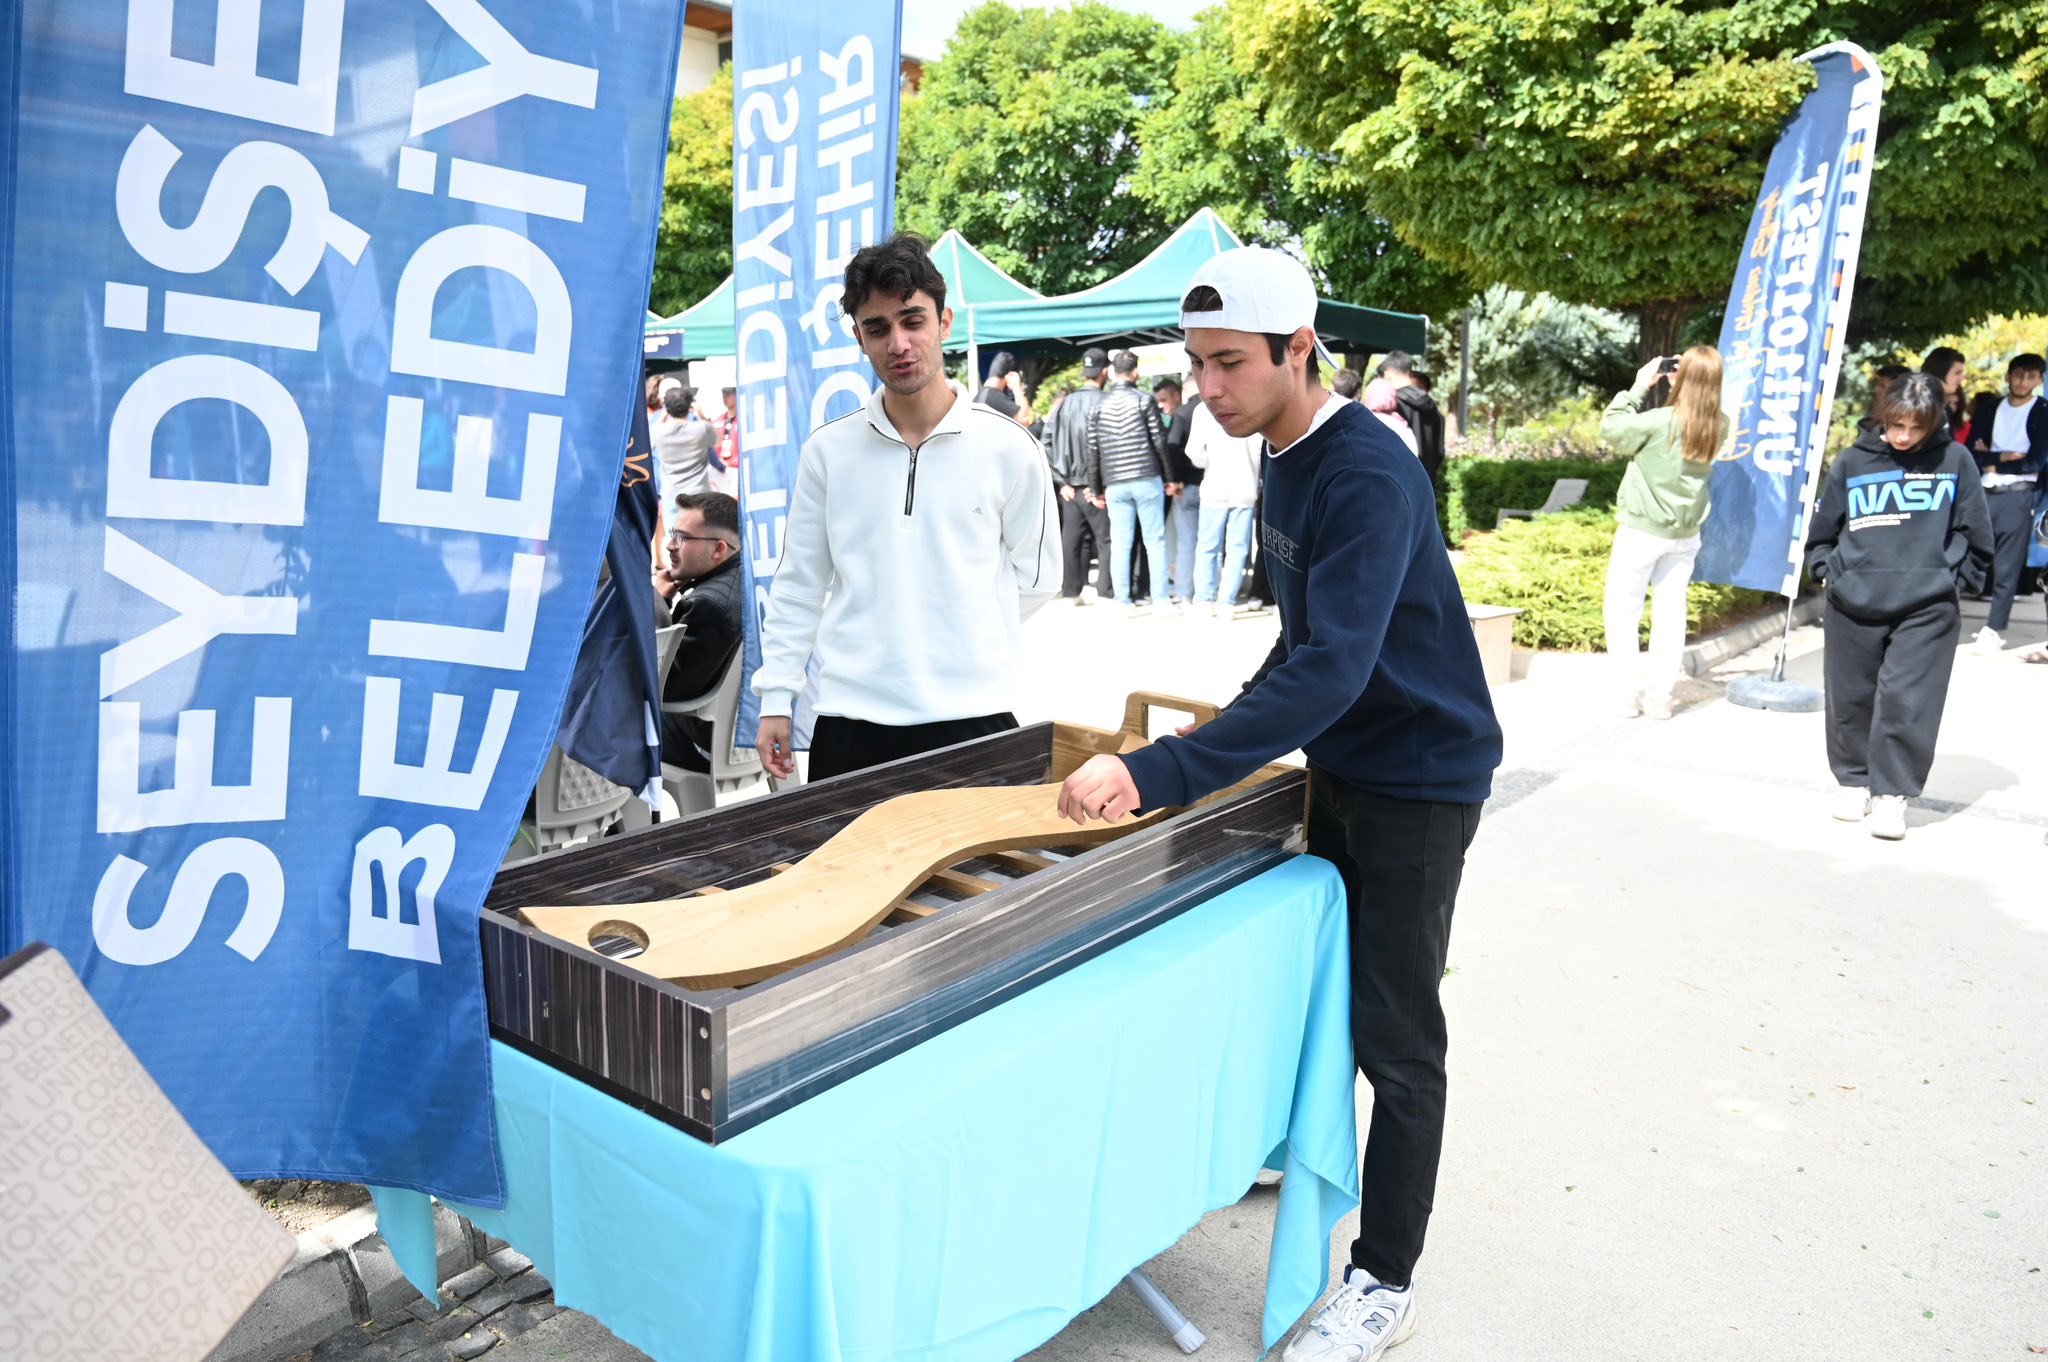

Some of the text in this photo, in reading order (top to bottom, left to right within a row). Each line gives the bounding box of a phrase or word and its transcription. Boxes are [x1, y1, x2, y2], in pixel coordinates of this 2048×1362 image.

[1848, 480, 1956, 518] NASA
[62, 1115, 152, 1201] UNITED
[46, 1197, 151, 1300] UNITED
[119, 1224, 165, 1270] OF
[173, 1287, 214, 1331] OF
